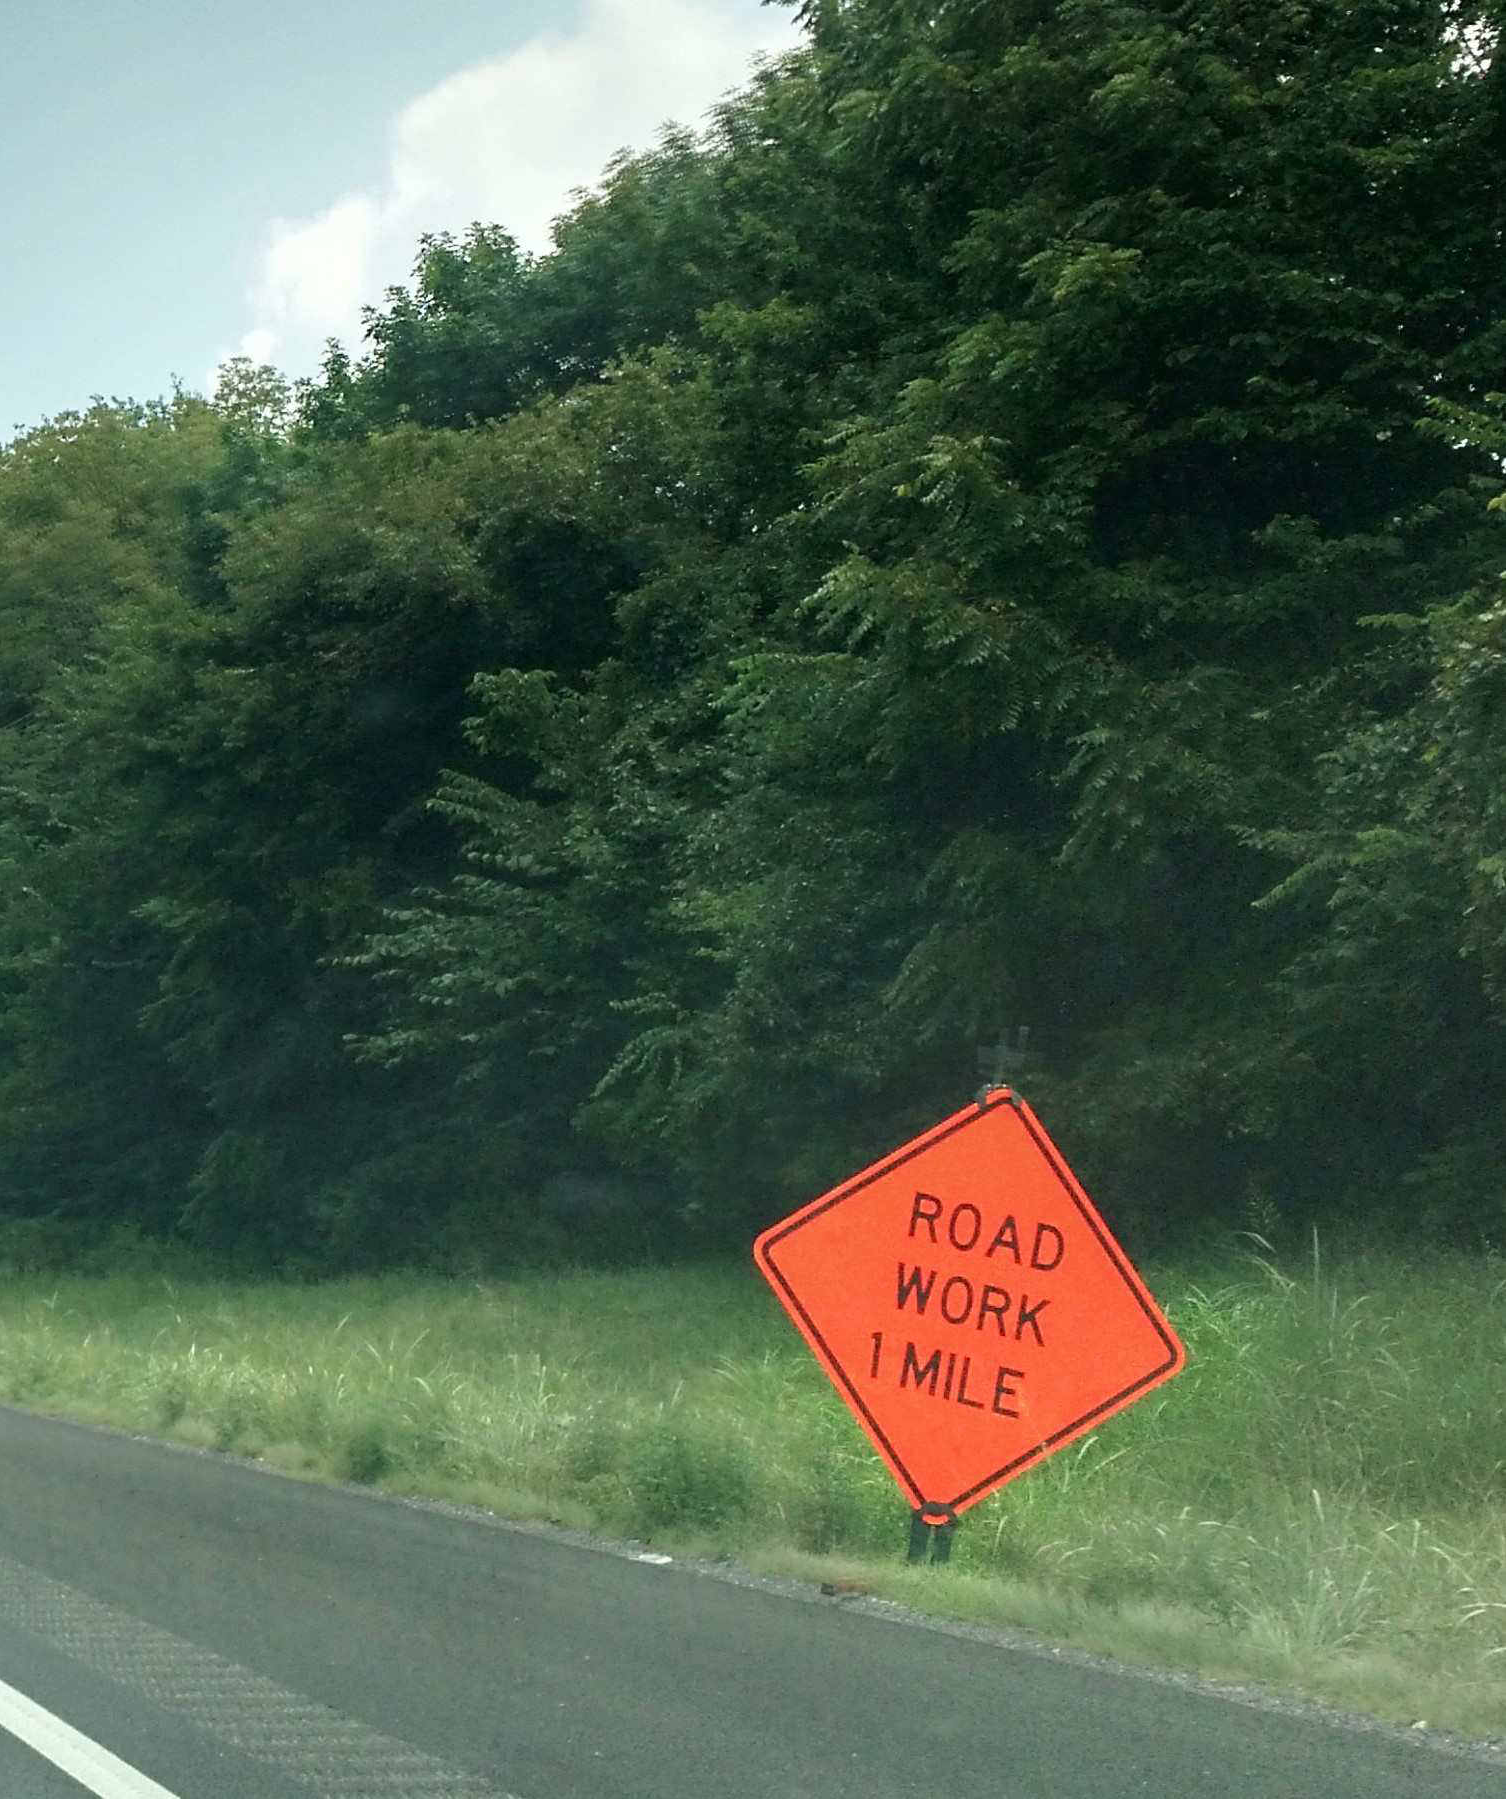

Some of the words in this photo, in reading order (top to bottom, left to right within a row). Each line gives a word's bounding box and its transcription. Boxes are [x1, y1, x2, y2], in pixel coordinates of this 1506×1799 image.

[908, 1191, 1065, 1272] ROAD
[896, 1261, 1051, 1347] WORK
[869, 1331, 883, 1378] 1
[899, 1341, 1025, 1419] MILE
